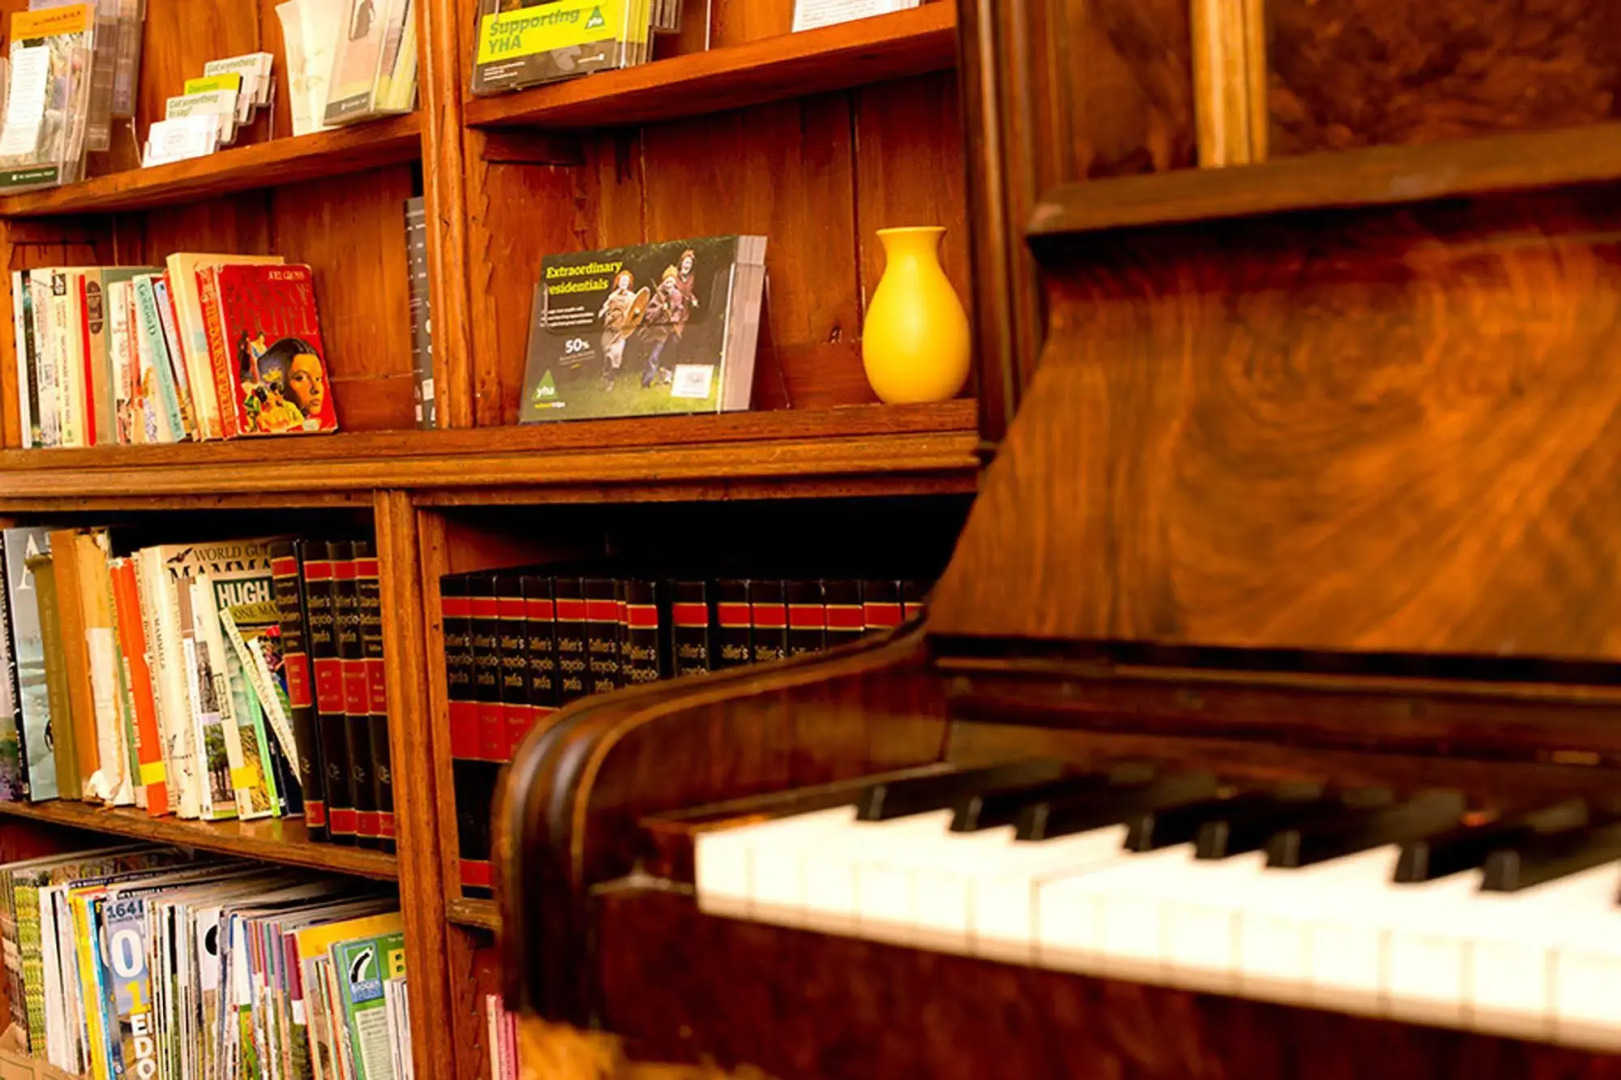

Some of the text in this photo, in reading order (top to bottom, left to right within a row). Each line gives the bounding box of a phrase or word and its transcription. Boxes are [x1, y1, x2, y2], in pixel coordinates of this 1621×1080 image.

[490, 10, 580, 36] Supporting
[488, 35, 521, 54] YHA
[546, 262, 622, 279] Extraordinary
[548, 278, 609, 295] esidentials
[565, 338, 590, 353] 50%
[194, 546, 241, 562] WORLD
[217, 581, 270, 608] HUGH
